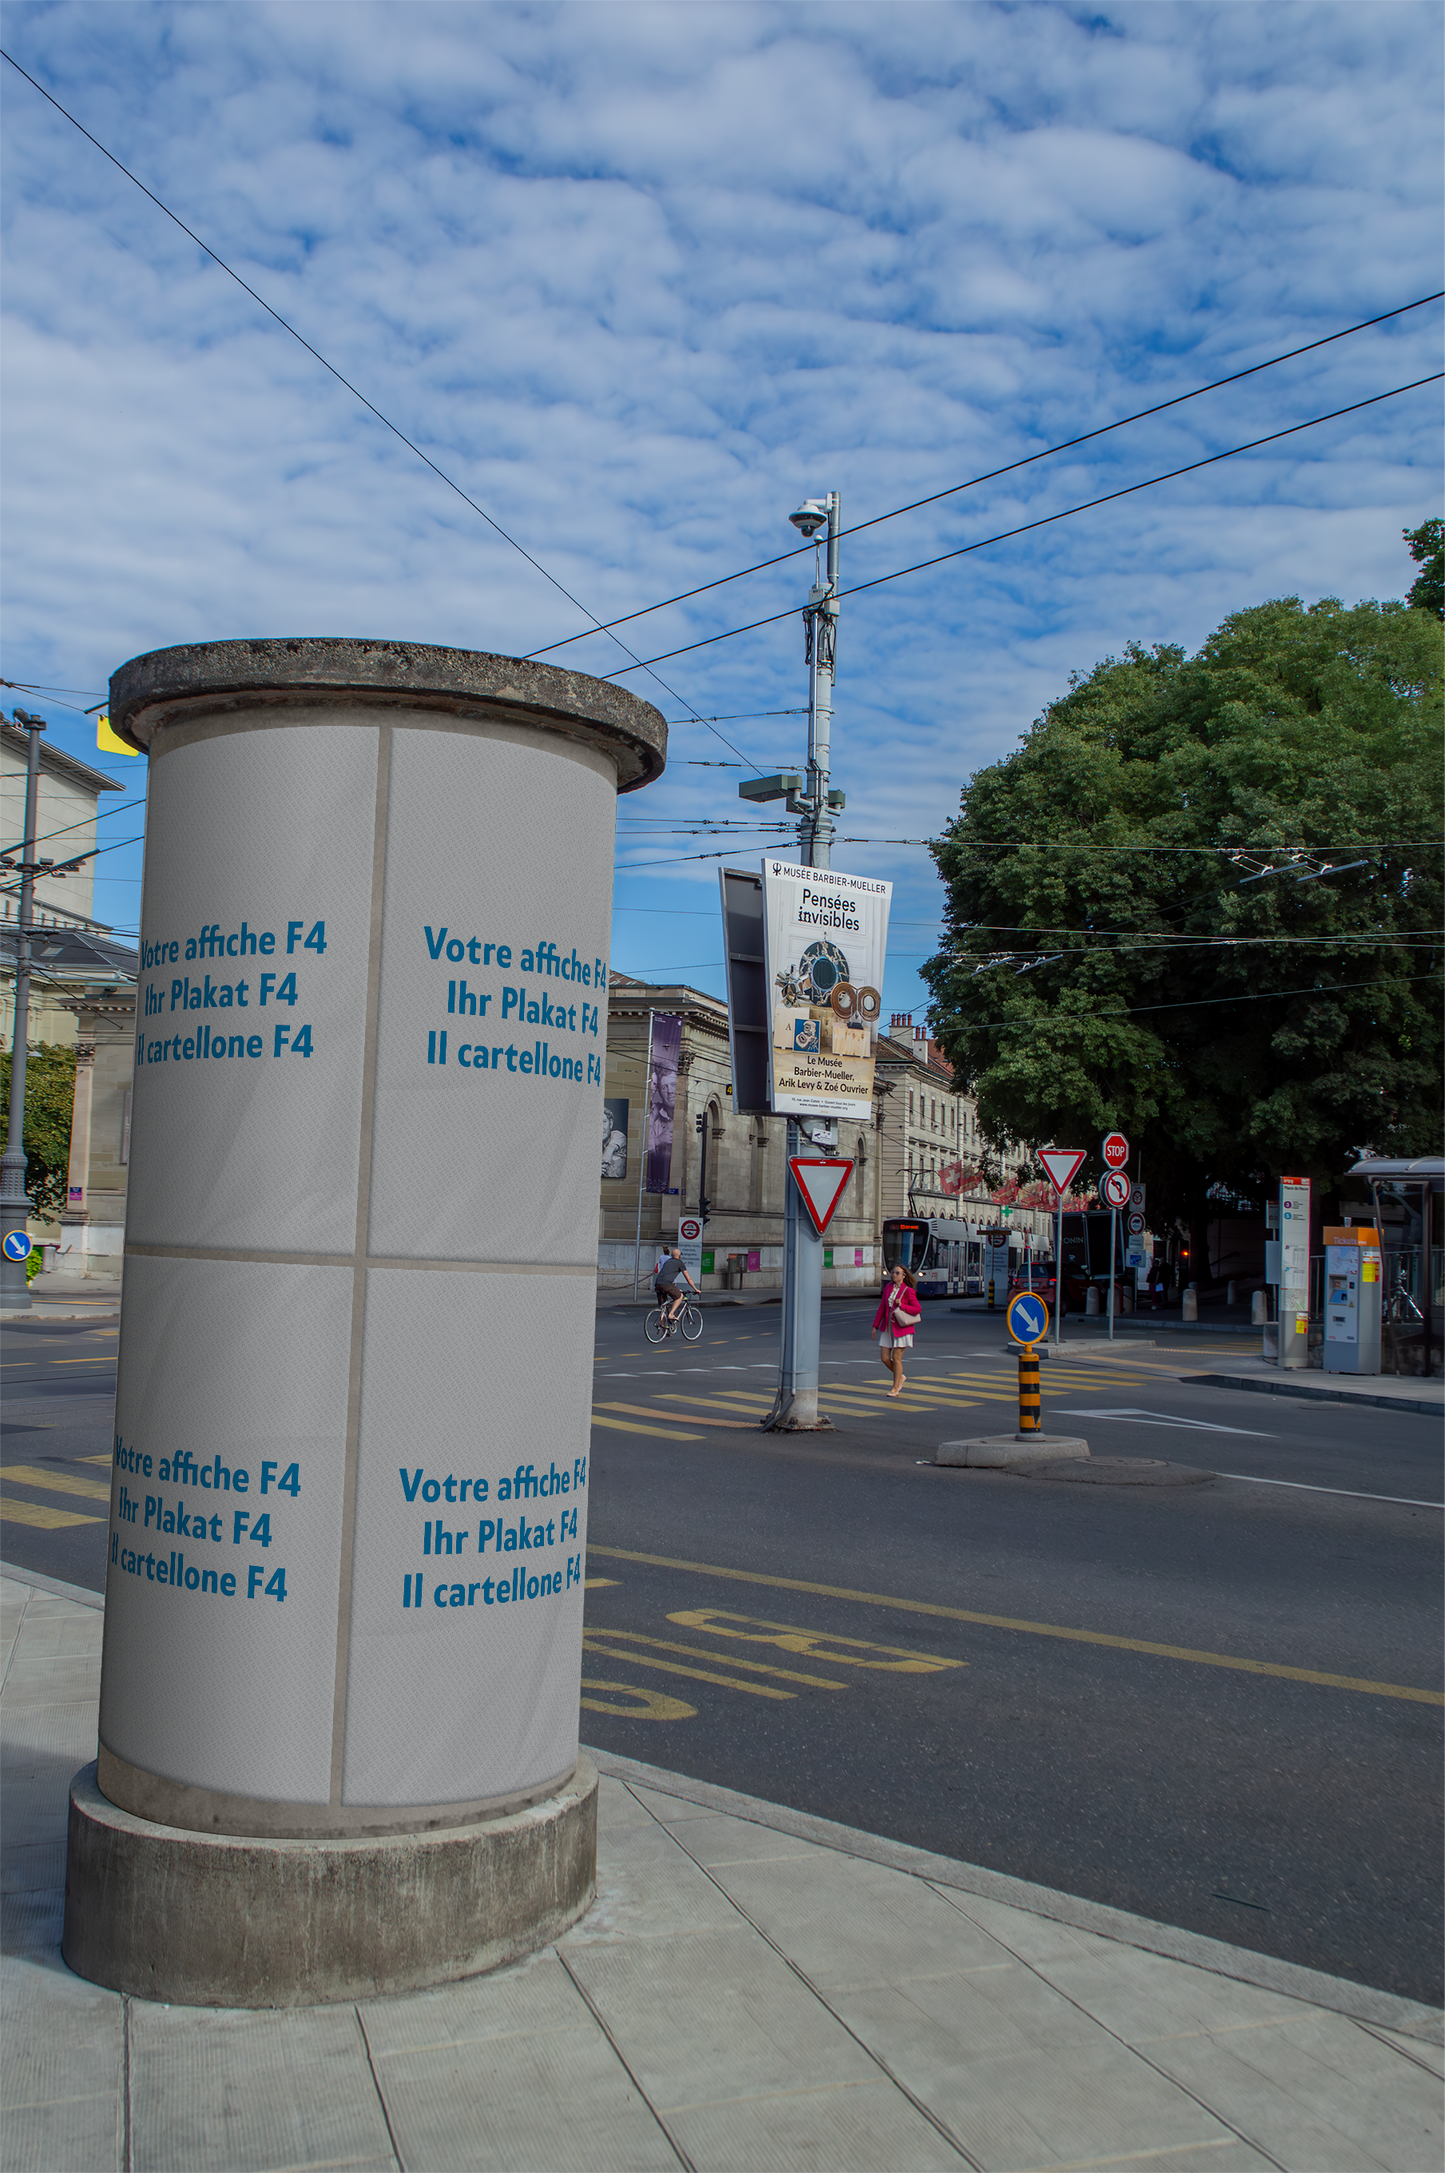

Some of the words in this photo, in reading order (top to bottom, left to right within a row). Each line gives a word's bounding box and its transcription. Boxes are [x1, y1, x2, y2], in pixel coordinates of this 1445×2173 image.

[783, 866, 811, 880] MUSÉE
[813, 872, 886, 894] BARBIER-MUELLER
[803, 888, 856, 913] Pensées
[798, 906, 860, 931] invisibles
[141, 939, 179, 971] Votre
[185, 921, 276, 961] affiche
[287, 921, 328, 955] F4
[424, 926, 512, 969] Votre
[521, 941, 591, 986] affiche
[594, 957, 606, 994] F4
[145, 983, 165, 1016] Ihr
[171, 975, 249, 1012] Plakat
[260, 972, 298, 1007] F4
[448, 980, 492, 1017] Ihr
[502, 986, 577, 1032] Plakat
[582, 1002, 599, 1038] F4
[138, 1033, 145, 1066] Il
[147, 1025, 263, 1064] cartellone
[274, 1024, 314, 1059] F4
[427, 1030, 447, 1065] Il
[458, 1041, 583, 1083] cartellone
[588, 1053, 600, 1088] F4
[807, 1055, 816, 1065] Le
[817, 1056, 843, 1068] Musée
[779, 1077, 796, 1088] Arik
[797, 1079, 815, 1091] Levy
[816, 1081, 822, 1090] &
[824, 1080, 839, 1092] Zoé
[840, 1083, 869, 1095] Ouvrier
[794, 1066, 855, 1082] Barbier-Mueller,
[1106, 1145, 1125, 1157] STOP
[1333, 1236, 1357, 1246] Tickets
[115, 1434, 152, 1478] Votre
[158, 1450, 249, 1493] affiche
[261, 1460, 301, 1497] F4
[399, 1468, 489, 1503] Votre
[498, 1462, 570, 1502] affiche
[573, 1456, 586, 1491] F4
[119, 1486, 139, 1523] Ihr
[144, 1495, 222, 1542] Plakat
[233, 1510, 272, 1547] F4
[423, 1520, 469, 1555] Ihr
[478, 1516, 555, 1554] Plakat
[560, 1507, 578, 1543] F4
[112, 1532, 119, 1565] Il
[121, 1548, 237, 1597] cartellone
[247, 1564, 288, 1602] F4
[403, 1573, 423, 1608] Il
[434, 1566, 562, 1608] cartellone
[566, 1553, 581, 1589] F4
